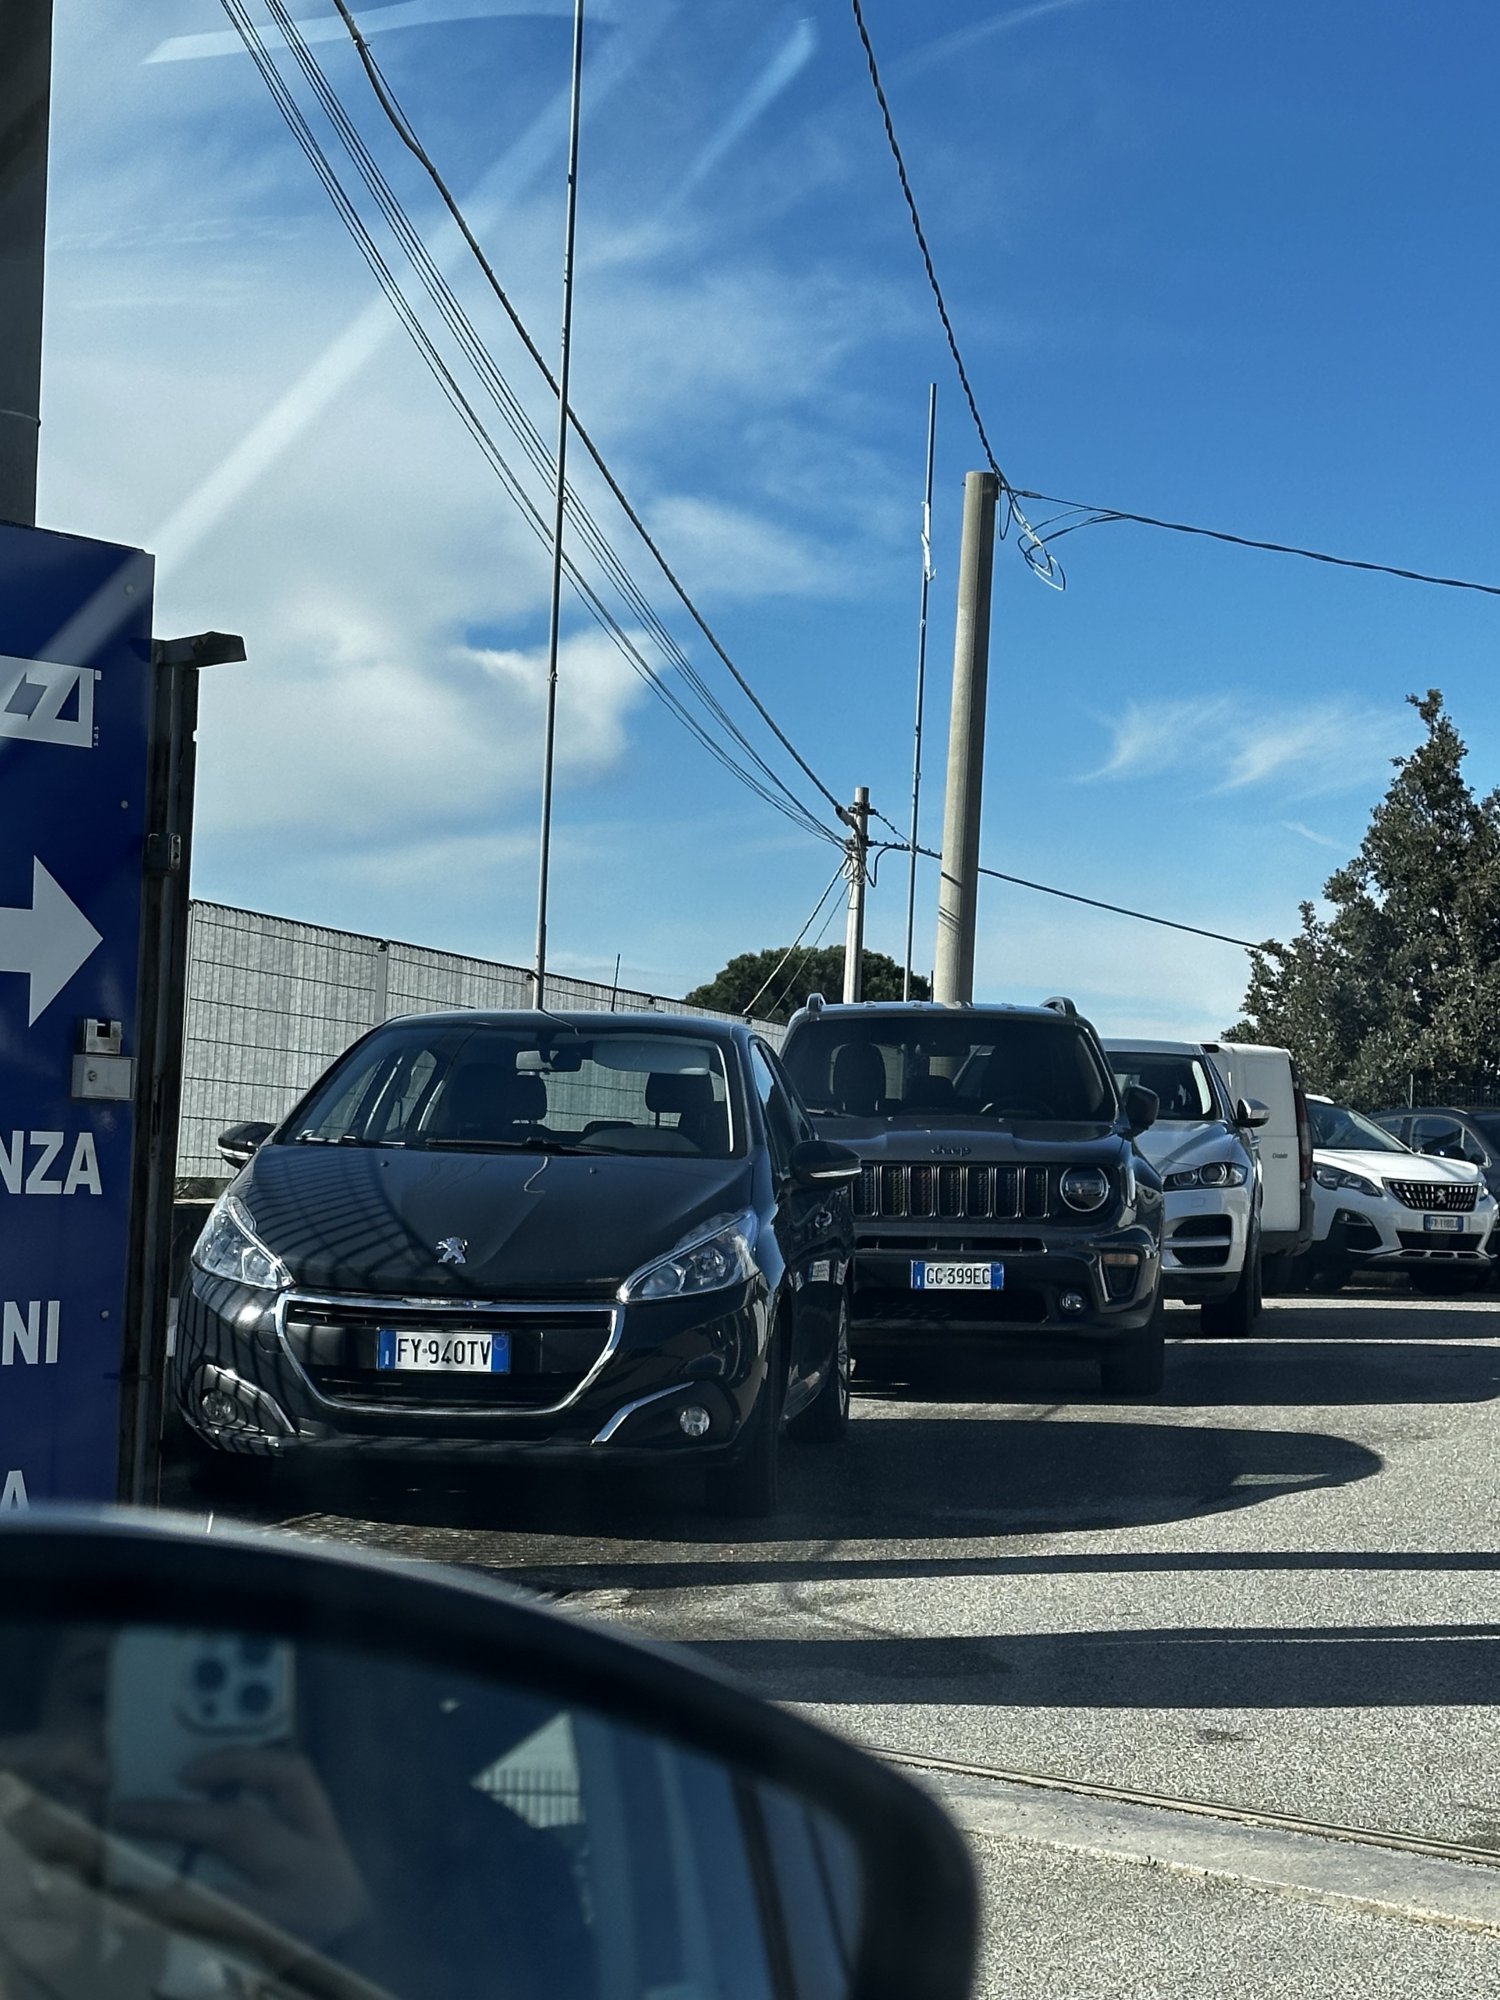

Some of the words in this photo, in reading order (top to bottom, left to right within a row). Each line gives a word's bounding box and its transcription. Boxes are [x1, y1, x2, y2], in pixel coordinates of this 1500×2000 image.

[0, 1130, 103, 1195] NZA
[2, 1300, 60, 1366] NI
[0, 1469, 30, 1512] A
